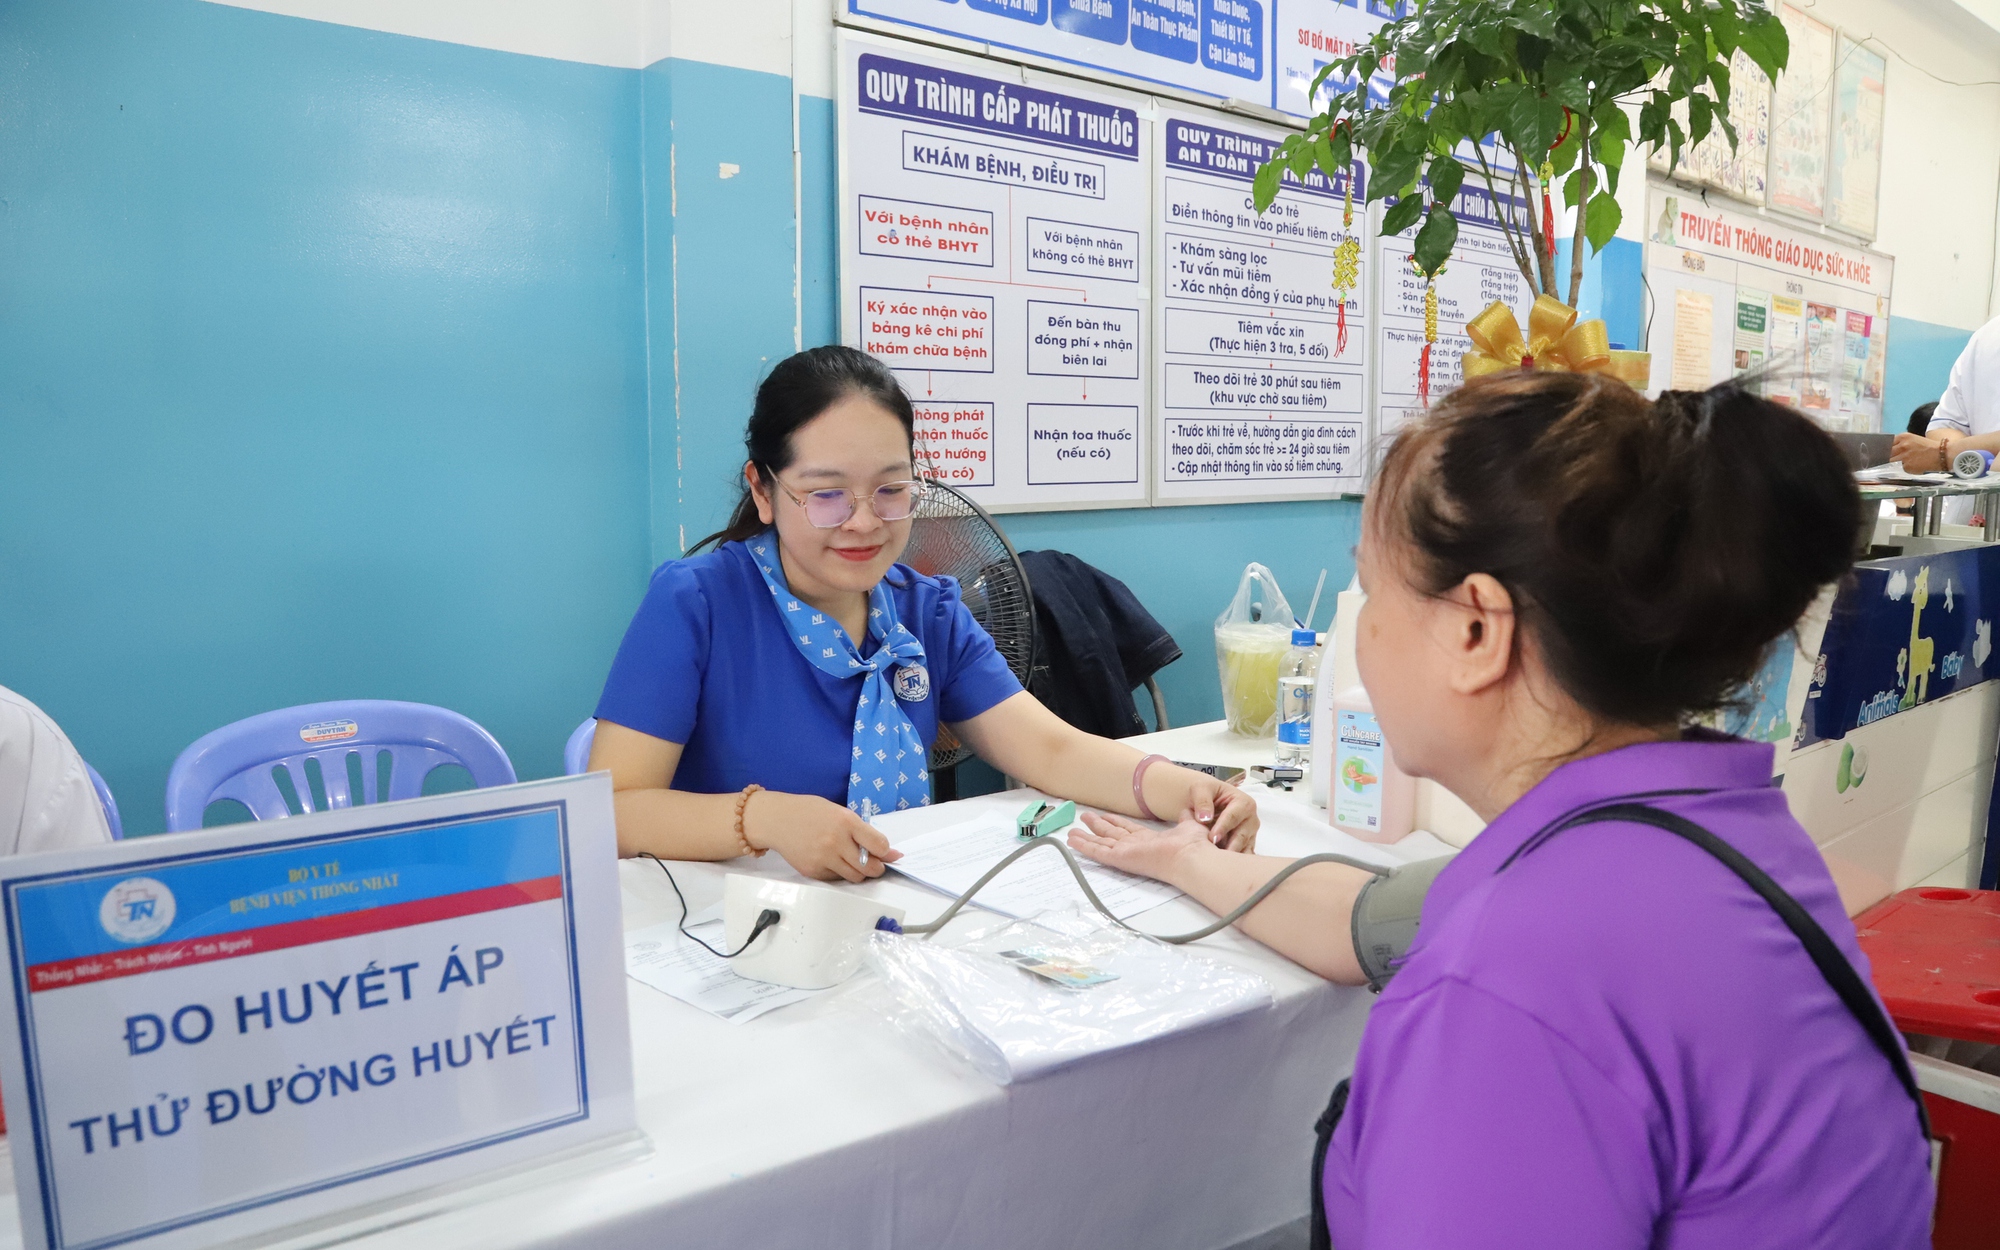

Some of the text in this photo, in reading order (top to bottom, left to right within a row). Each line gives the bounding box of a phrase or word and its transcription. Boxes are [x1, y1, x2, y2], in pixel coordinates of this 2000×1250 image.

[1131, 8, 1141, 26] An
[1237, 28, 1242, 41] Y
[1298, 28, 1310, 46] SƠ
[1209, 44, 1255, 73] Cận Lâm Sàng
[866, 69, 1133, 147] QUY TRÌNH CẤP PHÁT THUỐC
[1177, 127, 1263, 158] QUY TRÌNH
[1178, 146, 1248, 173] AN TOÀN
[913, 146, 1097, 195] KHÁM BỆNH, ĐIỀU TRỊ
[865, 210, 989, 235] Với bệnh nhân
[1172, 202, 1328, 240] Điền thông tin vào phiếu tiêm
[905, 235, 932, 248] thẻ
[938, 239, 978, 253] BHYT
[1044, 231, 1123, 250] Với bệnh nhân
[1680, 211, 1871, 285] TRUYỀN THÔNG GIÁO DỤC SỨC KHỎE
[1032, 248, 1134, 269] không có thẻ BHYT
[1180, 241, 1268, 268] Khám sàng lọc
[1180, 260, 1272, 283] Tư vấn mũi tiêm
[867, 300, 987, 320] Ký xác nhận vào
[872, 320, 984, 340] bảng kê chi phí
[1047, 315, 1121, 332] Đến bàn thu
[1238, 321, 1305, 338] Tiêm vắc xin
[867, 341, 987, 360] khám chữa bệnh
[1034, 334, 1067, 349] đóng
[1071, 336, 1091, 348] phí
[1104, 339, 1133, 352] nhận
[1209, 337, 1329, 359] (Thực hiện 3 tra, 5 đối)
[1062, 354, 1107, 366] biên lai
[1193, 371, 1341, 390] Theo dõi trẻ 30 phút sau tiêm
[1210, 390, 1328, 408] (khu vực chờ sau tiêm)
[953, 409, 985, 422] phát
[951, 427, 989, 440] thuốc
[1033, 428, 1132, 443] Nhận toa thuốc
[1178, 424, 1204, 437] Trước
[1206, 424, 1220, 437] khi
[1222, 423, 1235, 437] trẻ
[945, 447, 987, 462] hướng
[1056, 446, 1112, 461] (nếu có)
[952, 467, 975, 481] có)
[1857, 688, 1899, 727] Animals
[311, 866, 320, 879] Y
[123, 945, 506, 1058] ĐO HUYẾT ÁP
[70, 1014, 558, 1156] THỬ ĐƯỜNG HUYẾT
